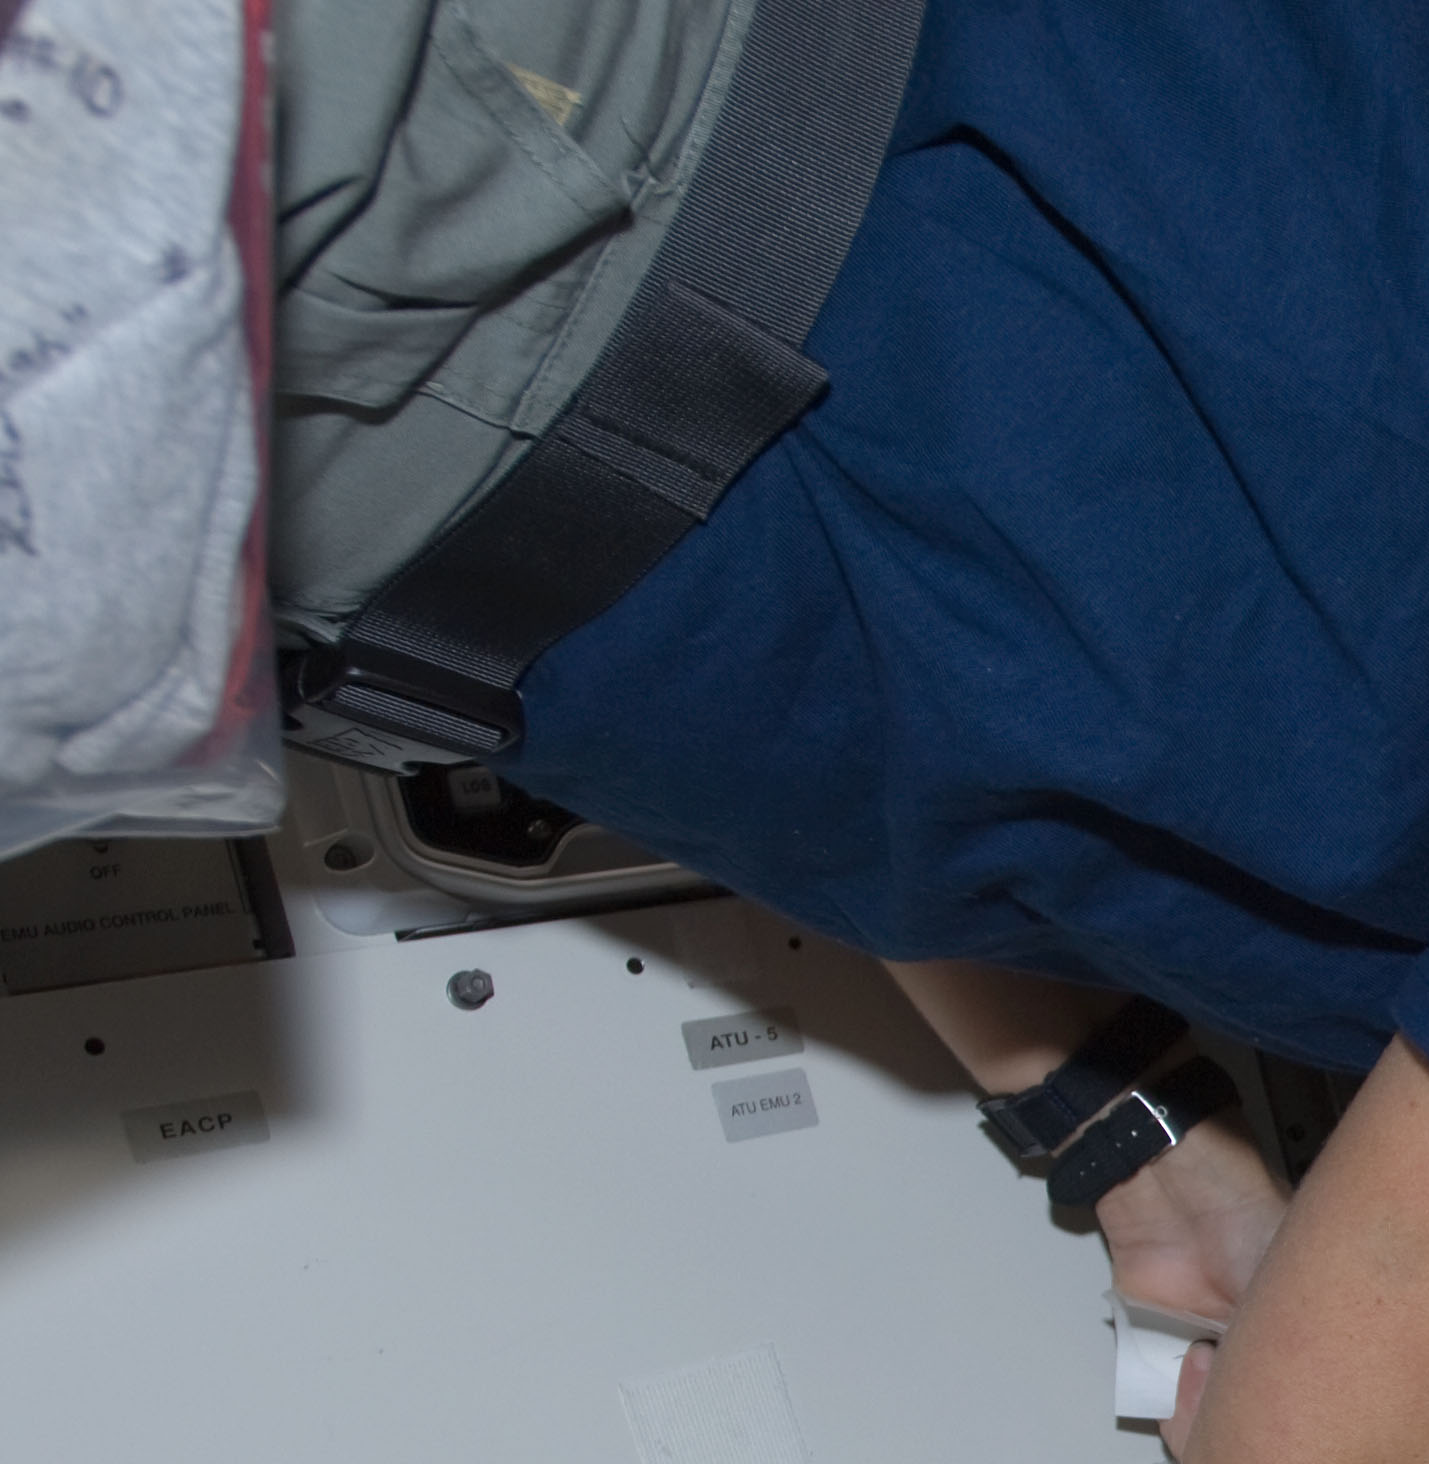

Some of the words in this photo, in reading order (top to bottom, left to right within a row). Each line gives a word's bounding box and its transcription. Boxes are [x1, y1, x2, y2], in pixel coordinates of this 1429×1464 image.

[89, 863, 122, 880] OFF
[0, 926, 39, 943] EMU
[44, 918, 96, 938] AUDIO
[100, 910, 177, 931] CONTROL
[183, 902, 233, 919] PANEL
[710, 1030, 749, 1051] ATU
[766, 1026, 779, 1042] 5
[731, 1102, 757, 1118] ATU
[759, 1095, 791, 1112] EMU
[792, 1092, 803, 1106] 2
[159, 1112, 233, 1140] EACP
